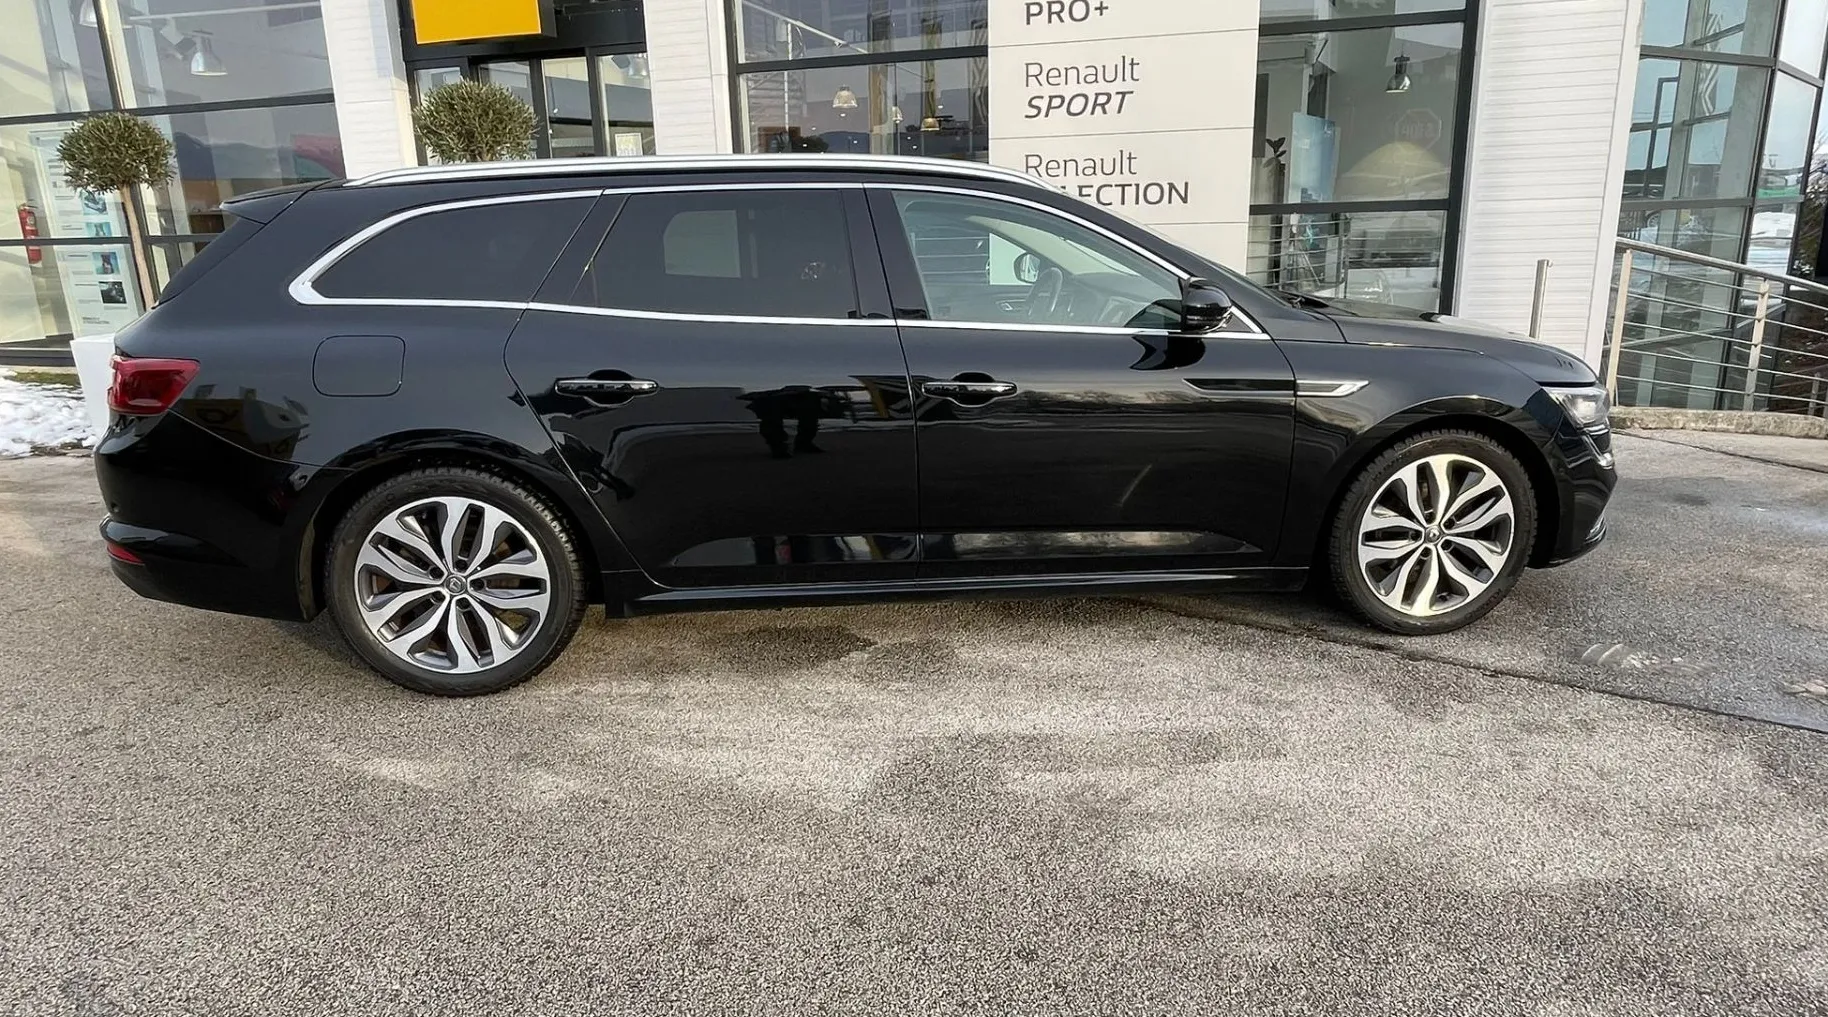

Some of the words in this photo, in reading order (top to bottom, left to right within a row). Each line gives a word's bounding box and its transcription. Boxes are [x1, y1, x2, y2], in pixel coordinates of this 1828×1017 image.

[1025, 0, 1109, 25] PRO+
[1025, 55, 1140, 87] Renault
[1024, 91, 1134, 118] SPORT
[1025, 150, 1138, 178] Renault
[1060, 181, 1189, 206] ECTION
